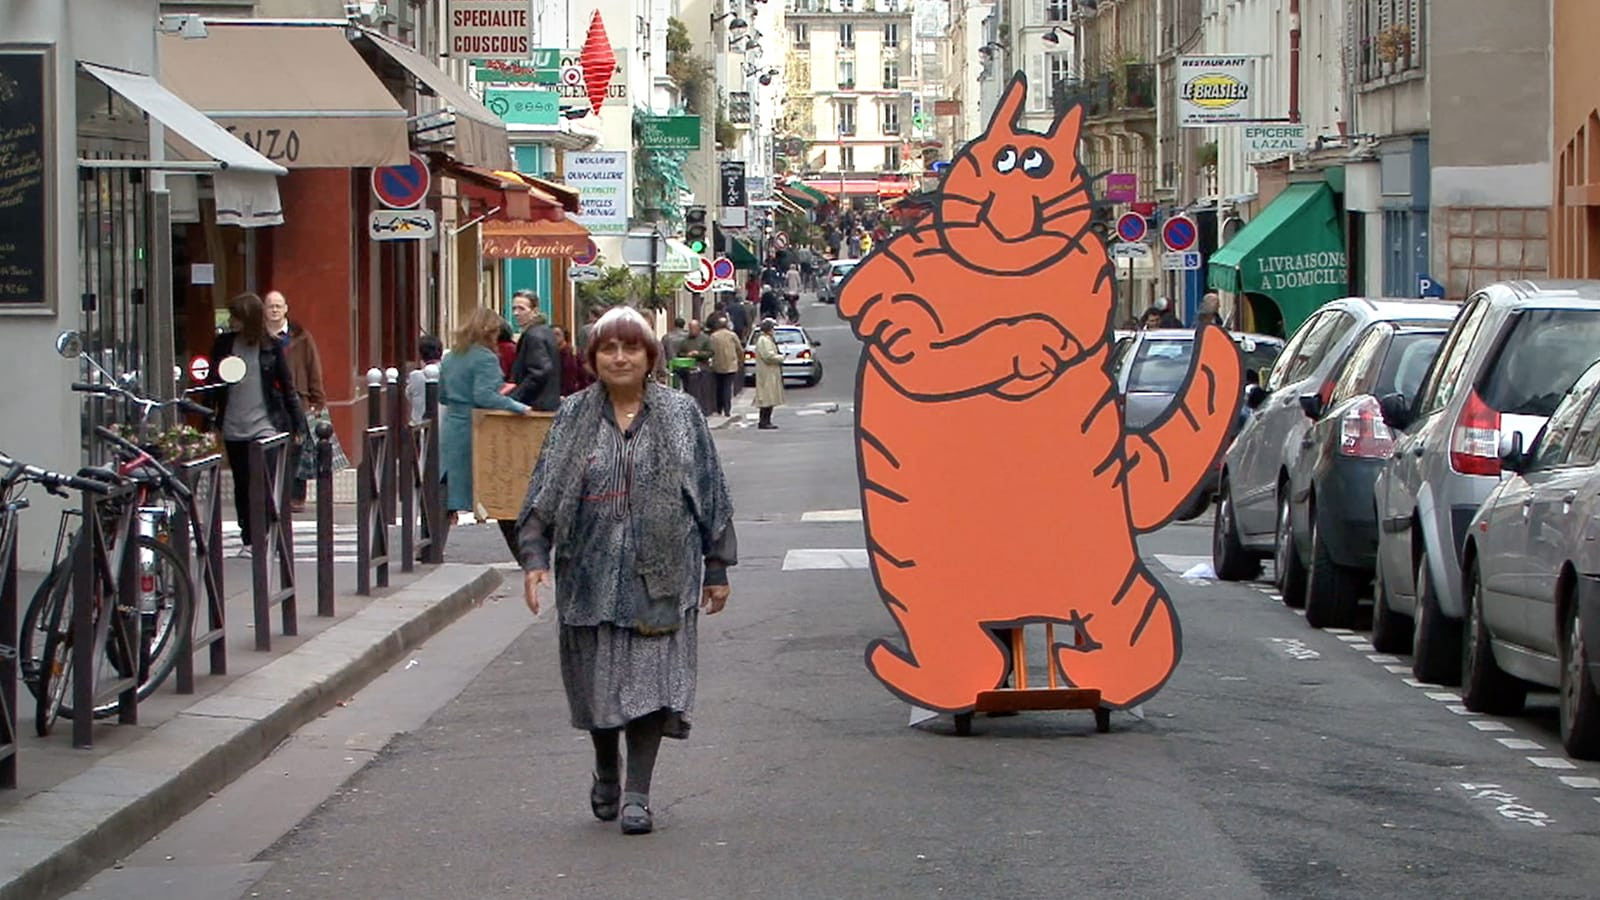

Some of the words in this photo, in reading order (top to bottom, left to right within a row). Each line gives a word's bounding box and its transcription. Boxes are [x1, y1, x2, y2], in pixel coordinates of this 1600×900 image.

[454, 10, 526, 27] SPECIALITE
[454, 36, 527, 53] COUSCOUS
[1182, 59, 1245, 67] RESTAURANT
[1181, 83, 1195, 99] LE
[1195, 83, 1248, 100] BRASIER
[1246, 128, 1304, 138] EPICERIE
[1252, 140, 1297, 149] LAZAL
[567, 171, 624, 180] QUINCAILLERIE
[581, 199, 613, 207] ARTICLES
[1258, 251, 1348, 272] LIVRAISONS
[1261, 275, 1272, 290] A
[1420, 280, 1431, 295] P
